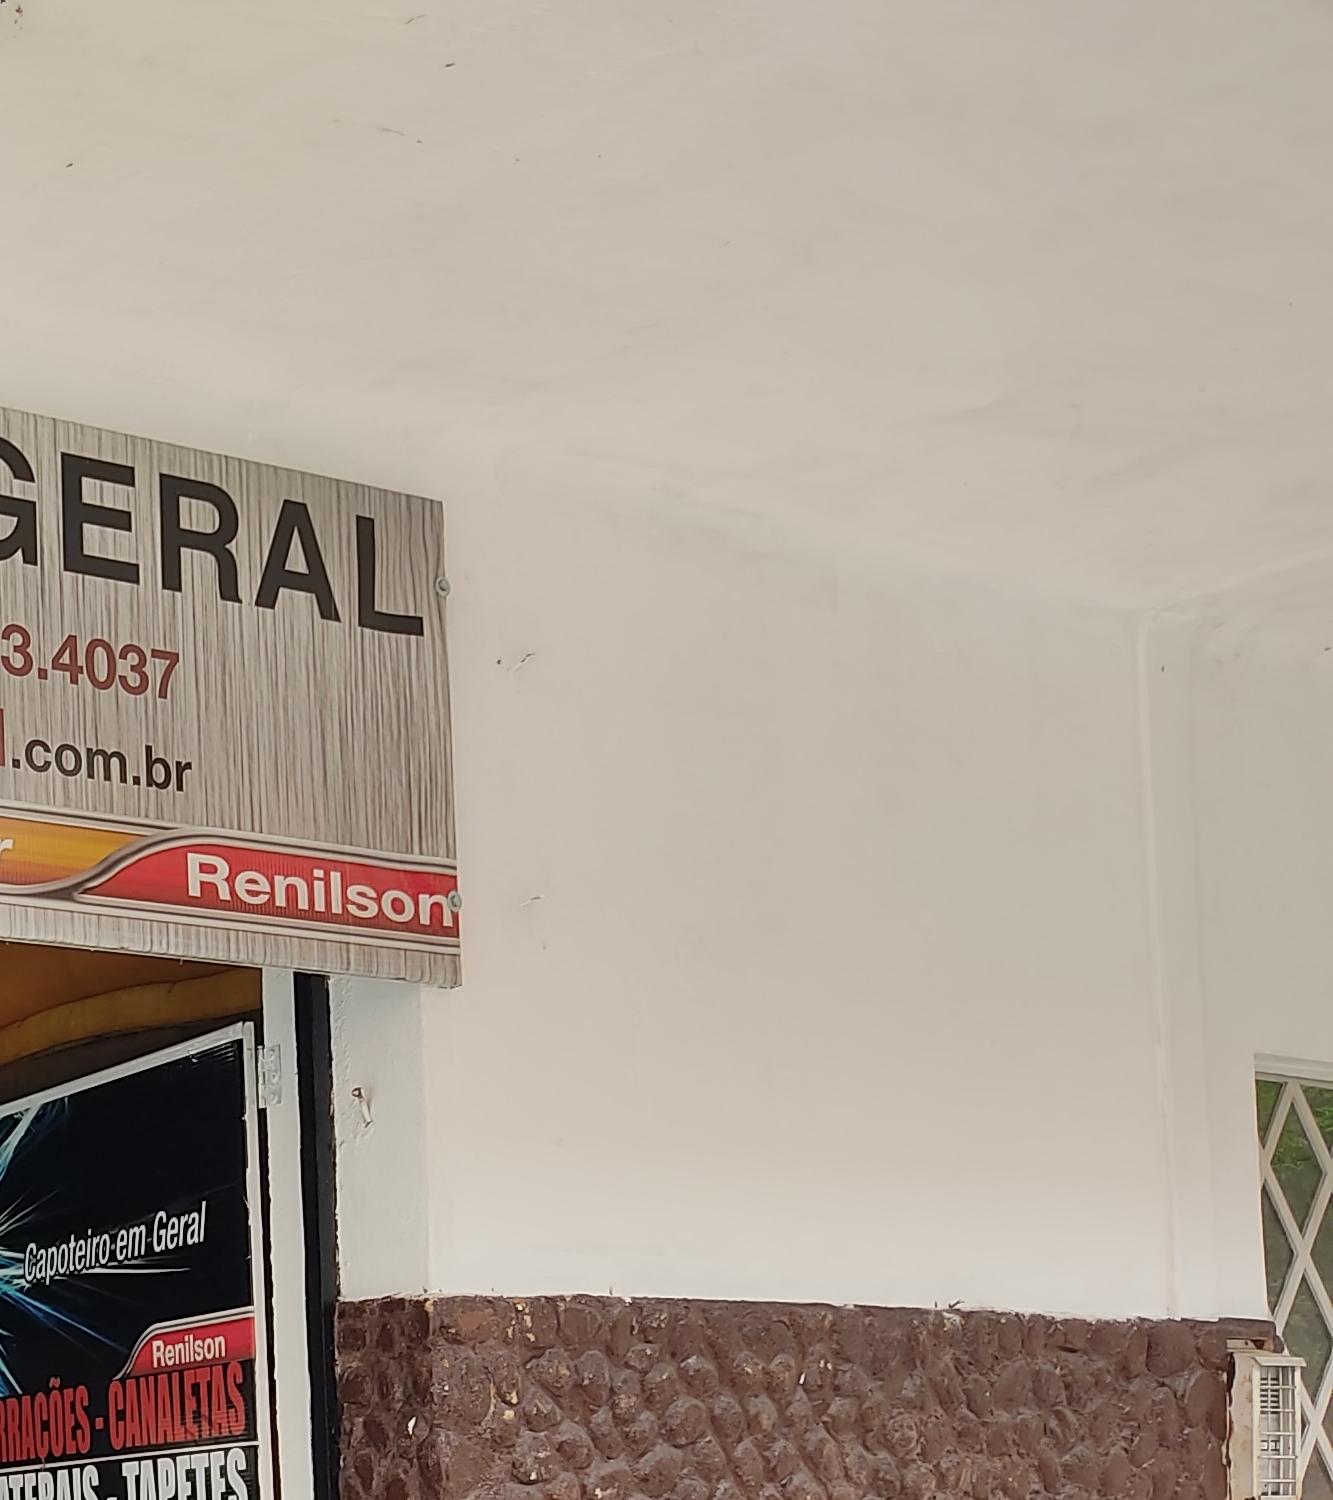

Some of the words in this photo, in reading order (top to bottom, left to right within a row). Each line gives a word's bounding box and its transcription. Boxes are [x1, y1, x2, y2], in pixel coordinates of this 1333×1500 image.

[186, 851, 456, 929] Renilson
[24, 1228, 109, 1285] Capoteiro
[115, 1223, 145, 1261] em
[153, 1200, 206, 1252] Geral
[152, 1335, 225, 1368] Renilson
[108, 1361, 246, 1448] CANALETAS
